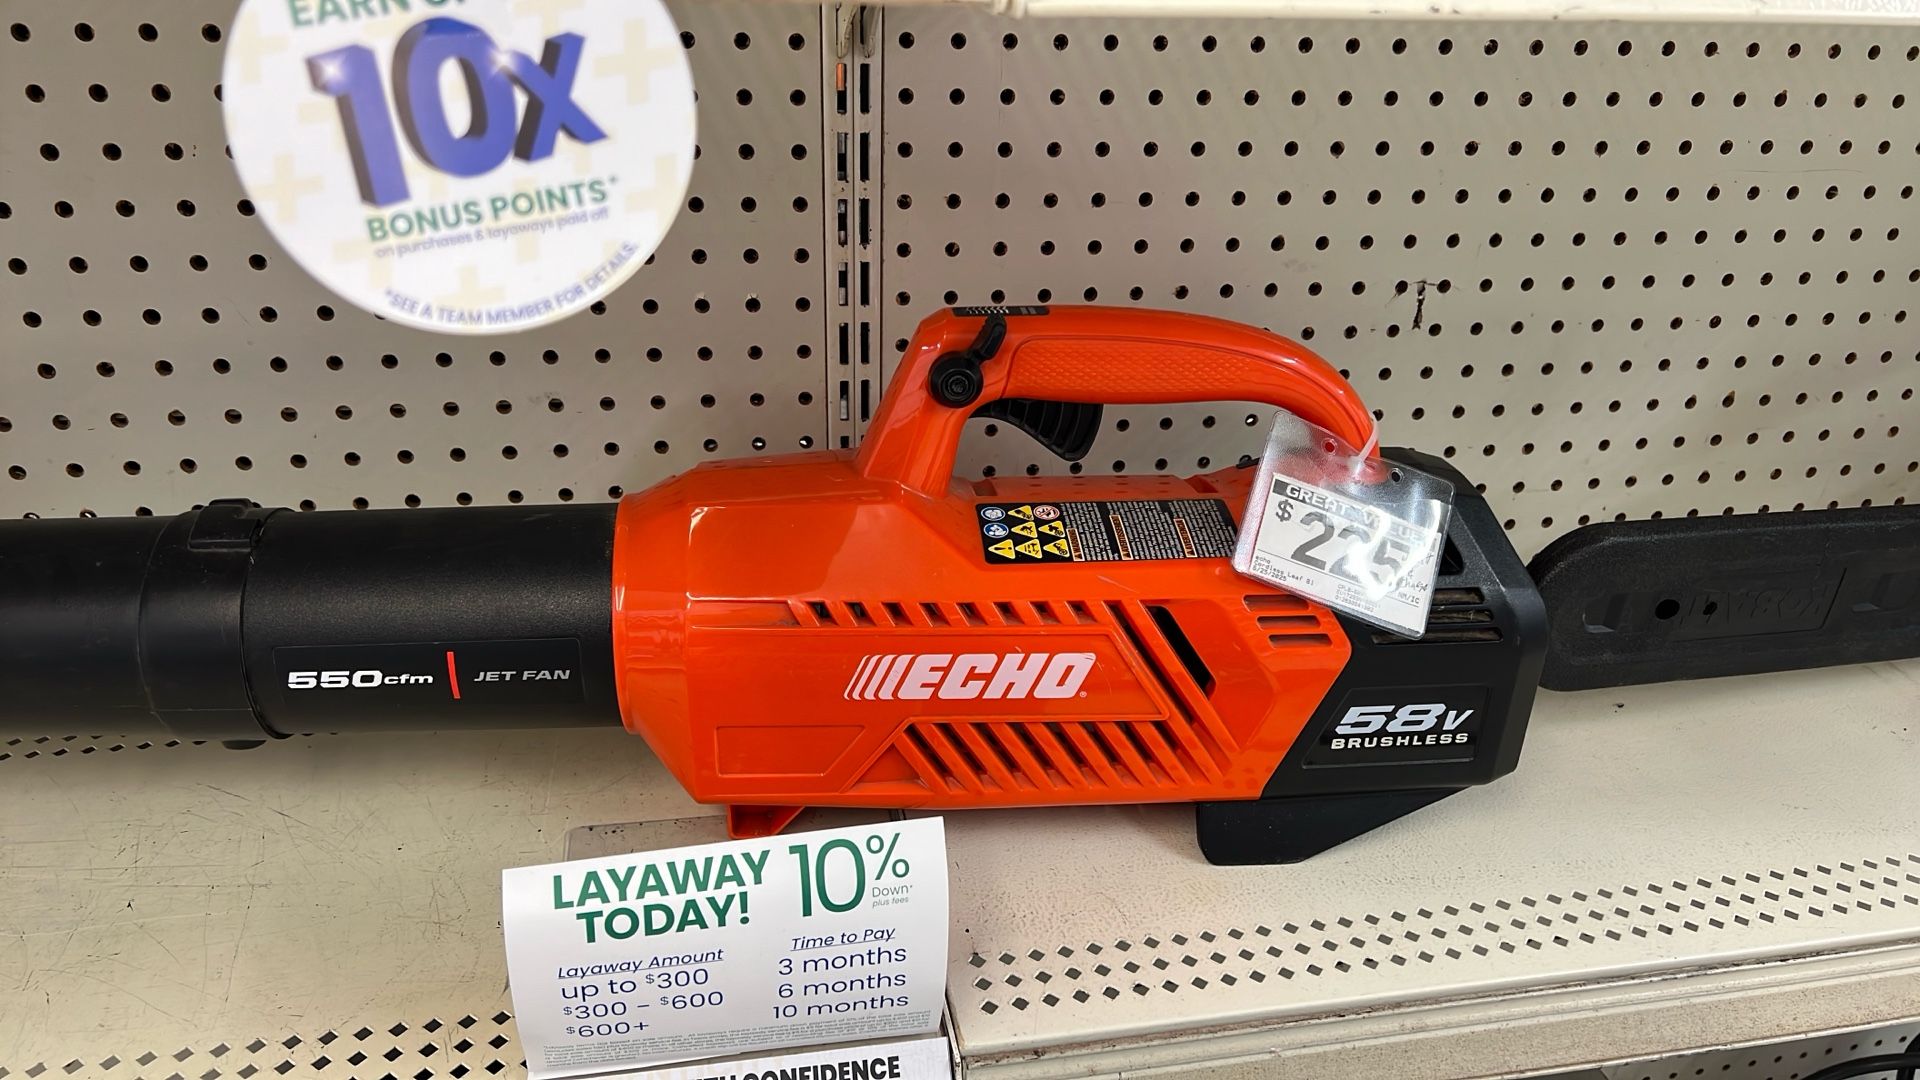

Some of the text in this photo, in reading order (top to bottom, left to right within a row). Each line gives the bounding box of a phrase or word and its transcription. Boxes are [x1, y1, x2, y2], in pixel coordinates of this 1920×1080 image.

[305, 16, 608, 207] 10x
[367, 200, 482, 242] BONUS
[375, 205, 609, 259] on purchases & layaways paid off
[419, 303, 434, 319] A
[436, 307, 483, 325] TEAM
[485, 298, 555, 325] MEMBER
[554, 284, 585, 309] FOR
[1285, 484, 1350, 515] GREAT
[288, 669, 434, 690] 550cfm
[473, 669, 571, 682] JET FAN
[897, 652, 1097, 700] ECHO
[1330, 733, 1469, 750] BRUSHLESS
[553, 849, 771, 909] LAYAWAY
[788, 832, 910, 917] 10%
[576, 891, 750, 944] TODAY!
[872, 896, 909, 909] plus fees
[791, 927, 896, 950] Time to Pay
[558, 948, 724, 980] Layaway Amount
[778, 946, 907, 976] 3 months
[561, 968, 709, 1003] up to $300
[778, 973, 906, 999] 6 months
[563, 1001, 627, 1020] $300
[659, 991, 724, 1010] $600
[773, 995, 909, 1019] 10 months
[565, 1021, 649, 1038] $600+
